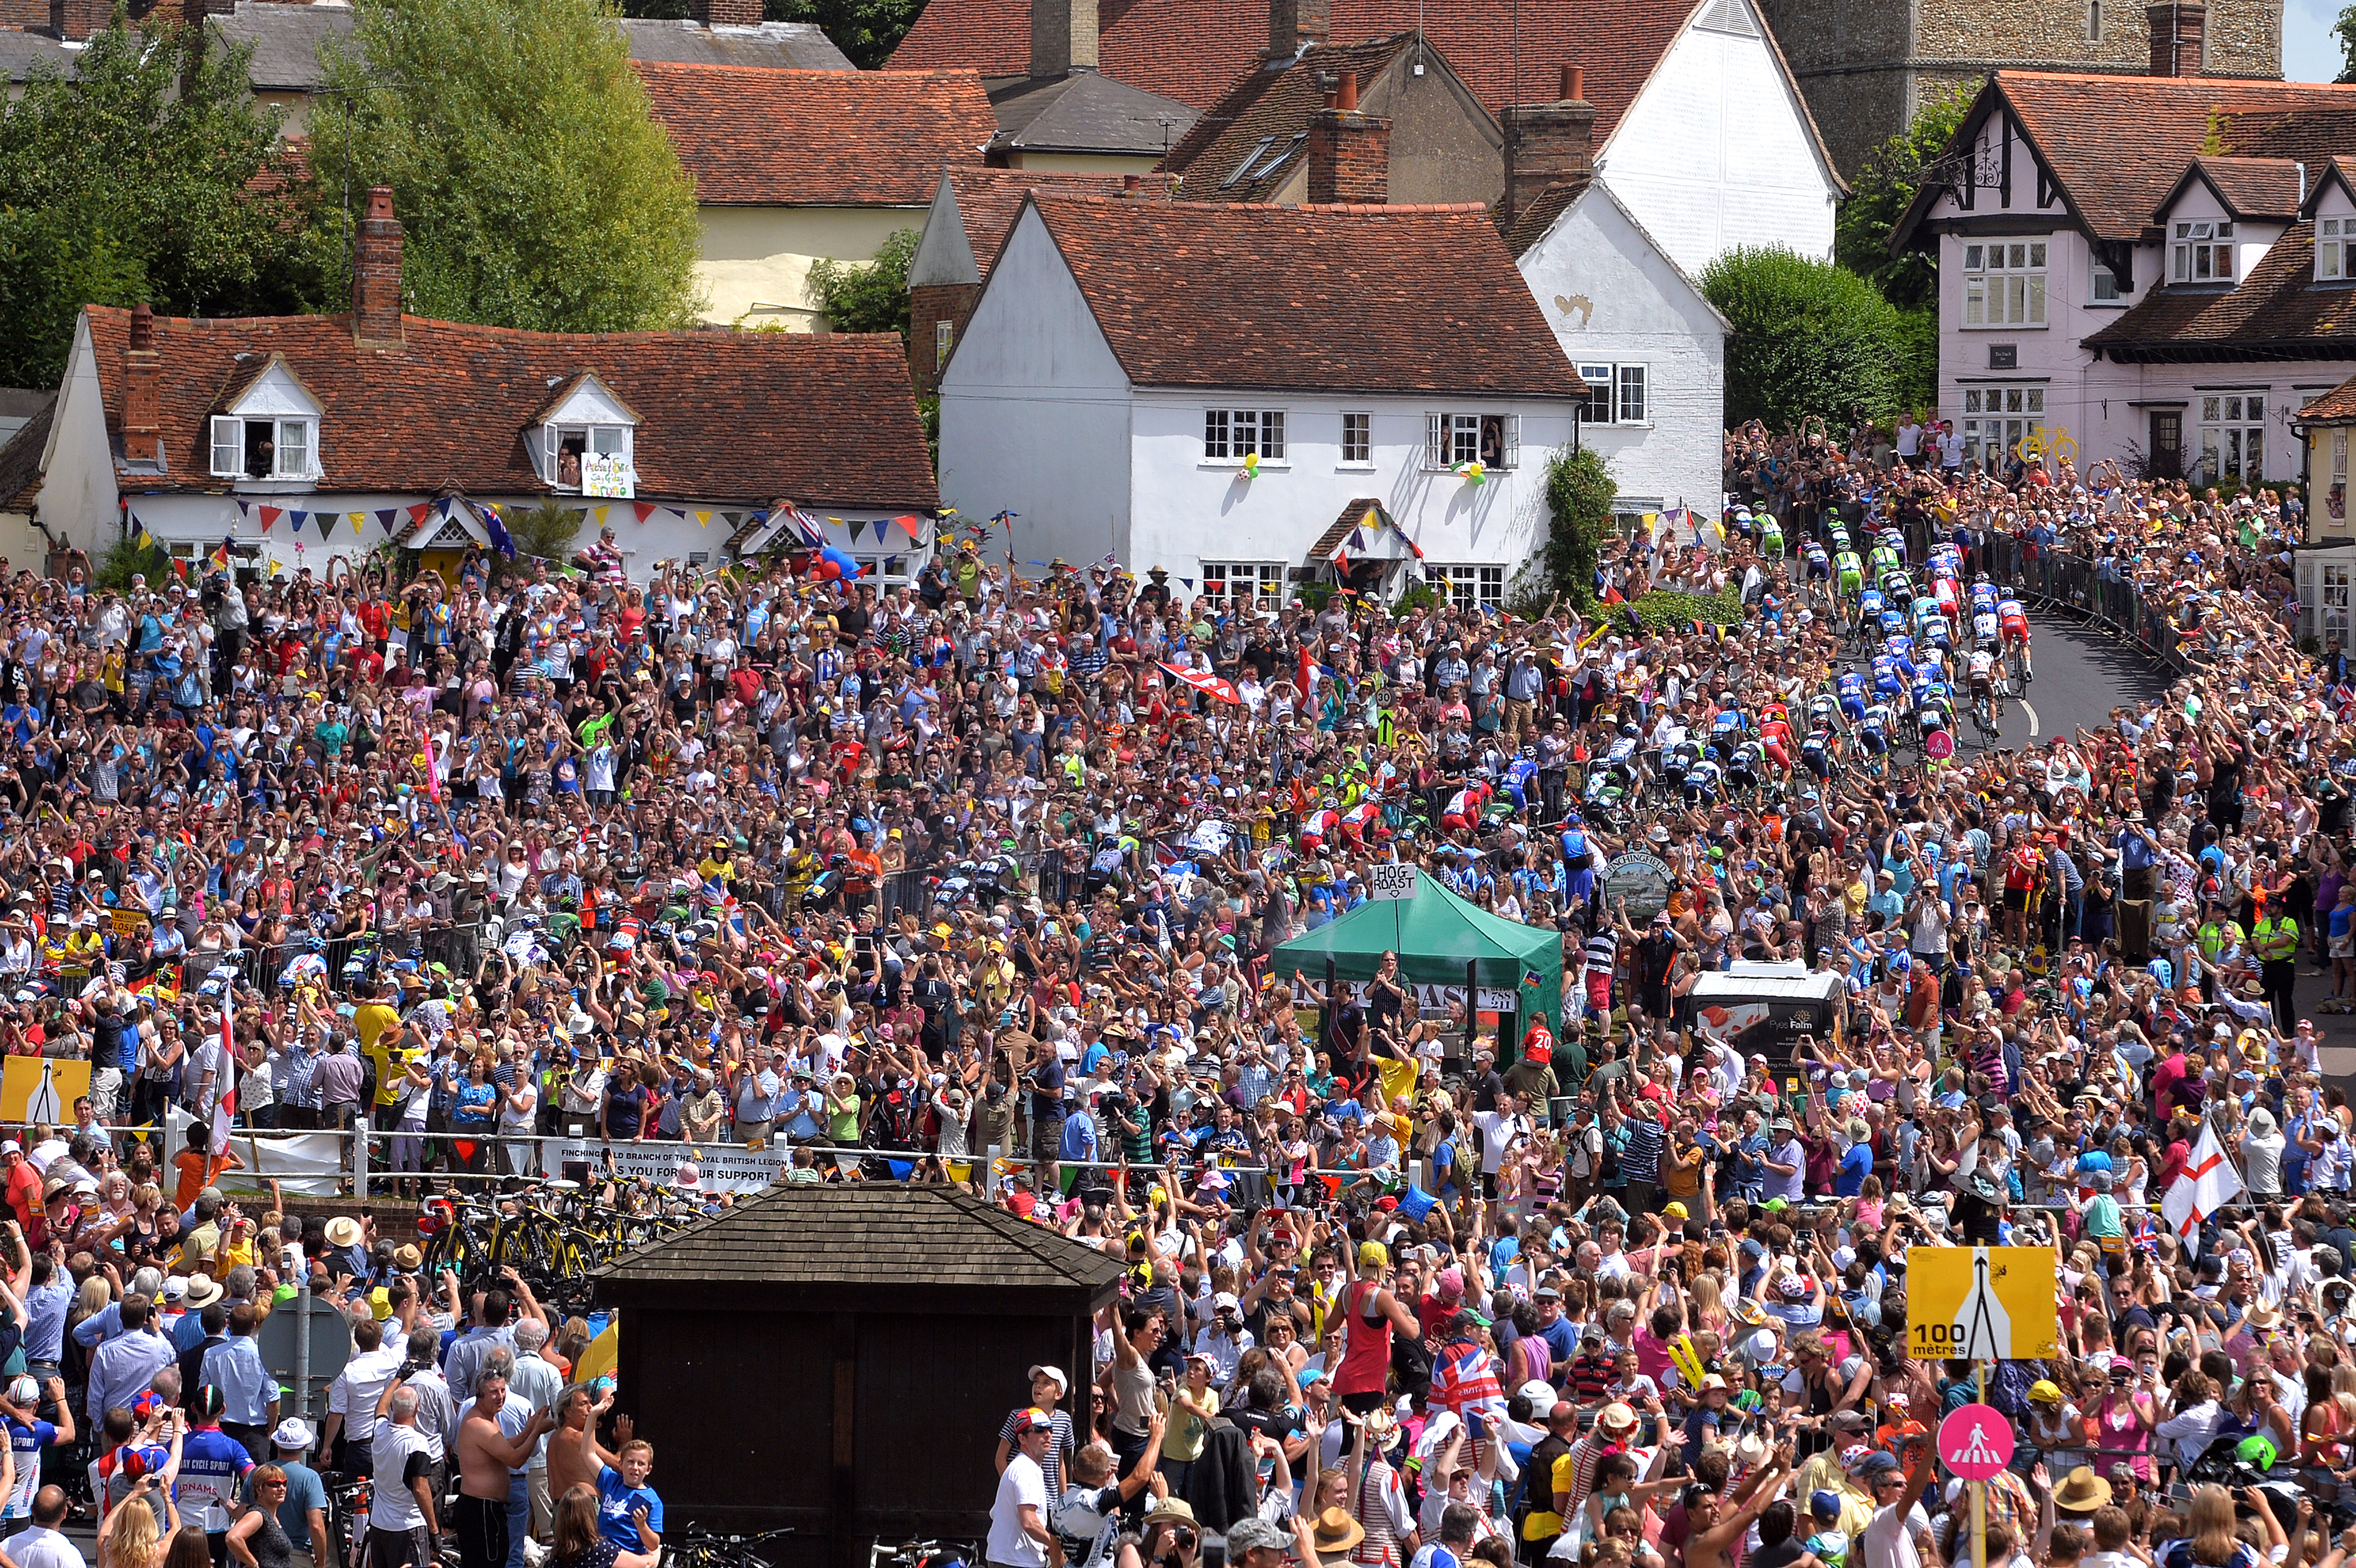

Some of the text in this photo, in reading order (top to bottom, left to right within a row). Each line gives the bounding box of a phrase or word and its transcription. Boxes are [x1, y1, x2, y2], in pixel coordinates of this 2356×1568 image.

[590, 482, 627, 496] Bruno
[1378, 693, 1389, 701] 30
[1607, 854, 1667, 872] FINCHINGFIELD
[1377, 865, 1408, 879] HOG
[1374, 877, 1415, 890] ROAST
[115, 913, 143, 922] WARNING
[1535, 1034, 1551, 1050] 20
[561, 1149, 623, 1159] FINCHINGLD
[626, 1153, 661, 1161] BRANCH
[723, 1157, 756, 1165] BRITISH
[628, 1166, 653, 1176] YOU
[657, 1168, 678, 1177] FOR
[717, 1171, 772, 1182] SUPPORT
[1914, 1324, 1966, 1343] 100
[1913, 1345, 1966, 1355] mètres
[13, 1437, 35, 1448] SPORT
[192, 1459, 208, 1470] CYCLE
[210, 1461, 229, 1471] SPORT
[178, 1482, 217, 1495] ADNAMS
[603, 1493, 628, 1517] Dodg
